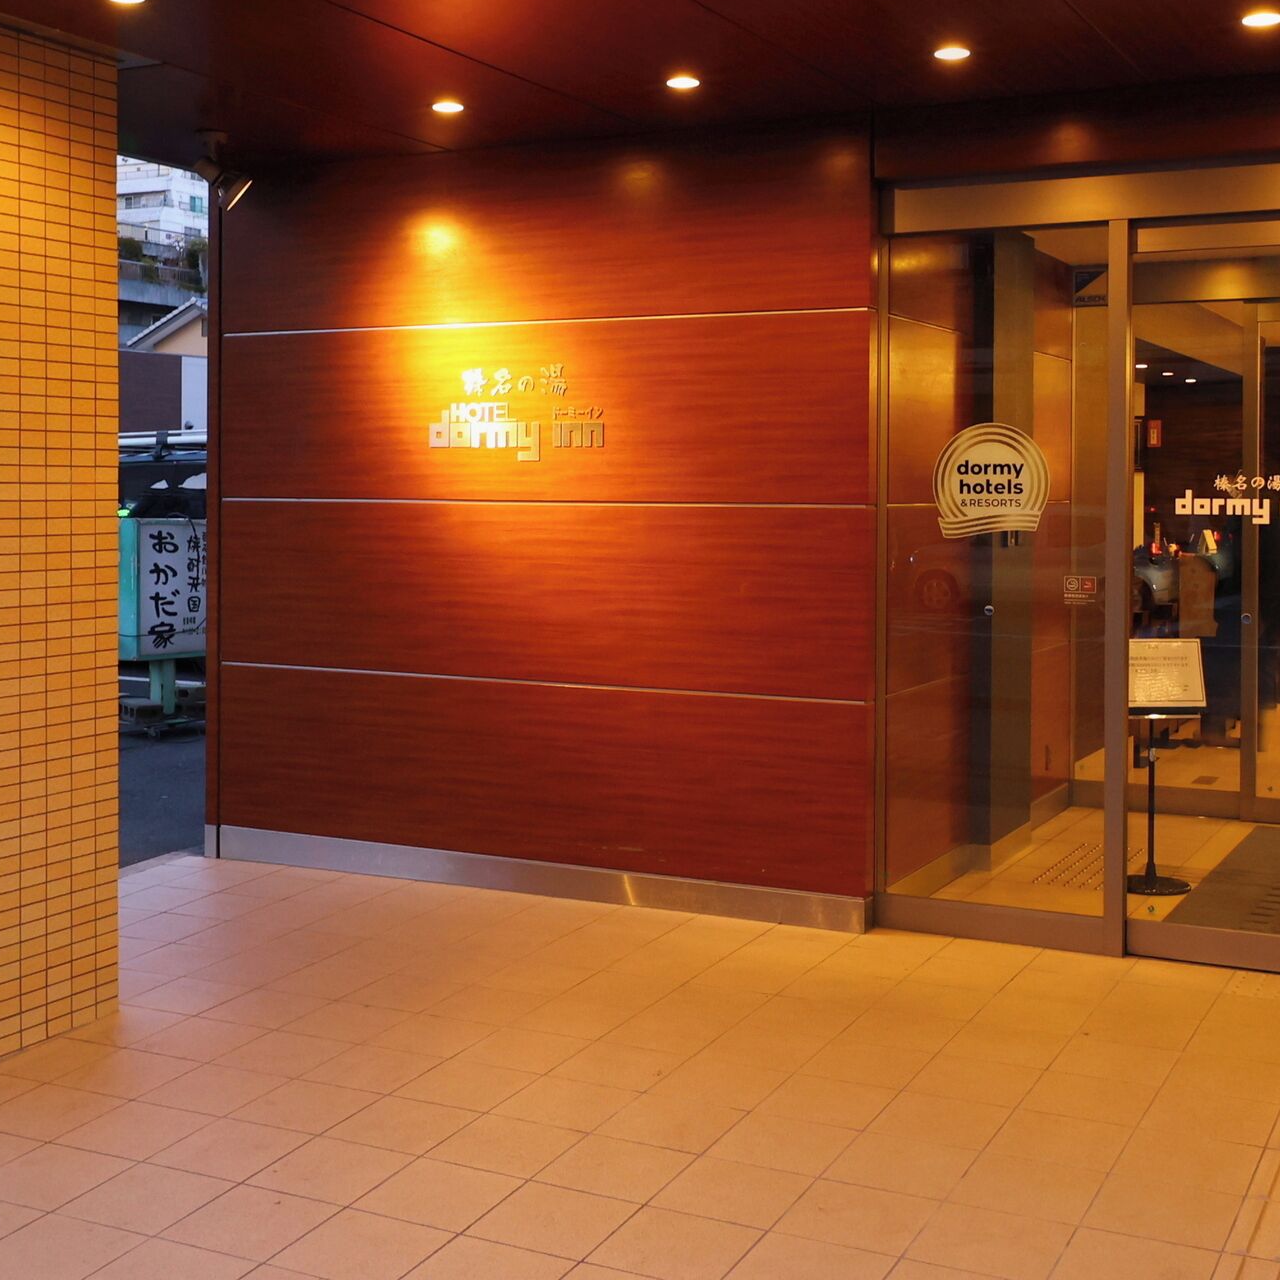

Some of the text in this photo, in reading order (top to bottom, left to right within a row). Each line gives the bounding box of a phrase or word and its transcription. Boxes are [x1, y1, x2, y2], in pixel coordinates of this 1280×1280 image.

[450, 402, 517, 422] HOTEL
[552, 407, 604, 419] ドーミーイン
[429, 410, 605, 462] dormy inn
[957, 460, 1024, 479] dormy
[959, 479, 1024, 495] hotels
[1175, 489, 1270, 524] dormy
[148, 530, 180, 649] おかだ家
